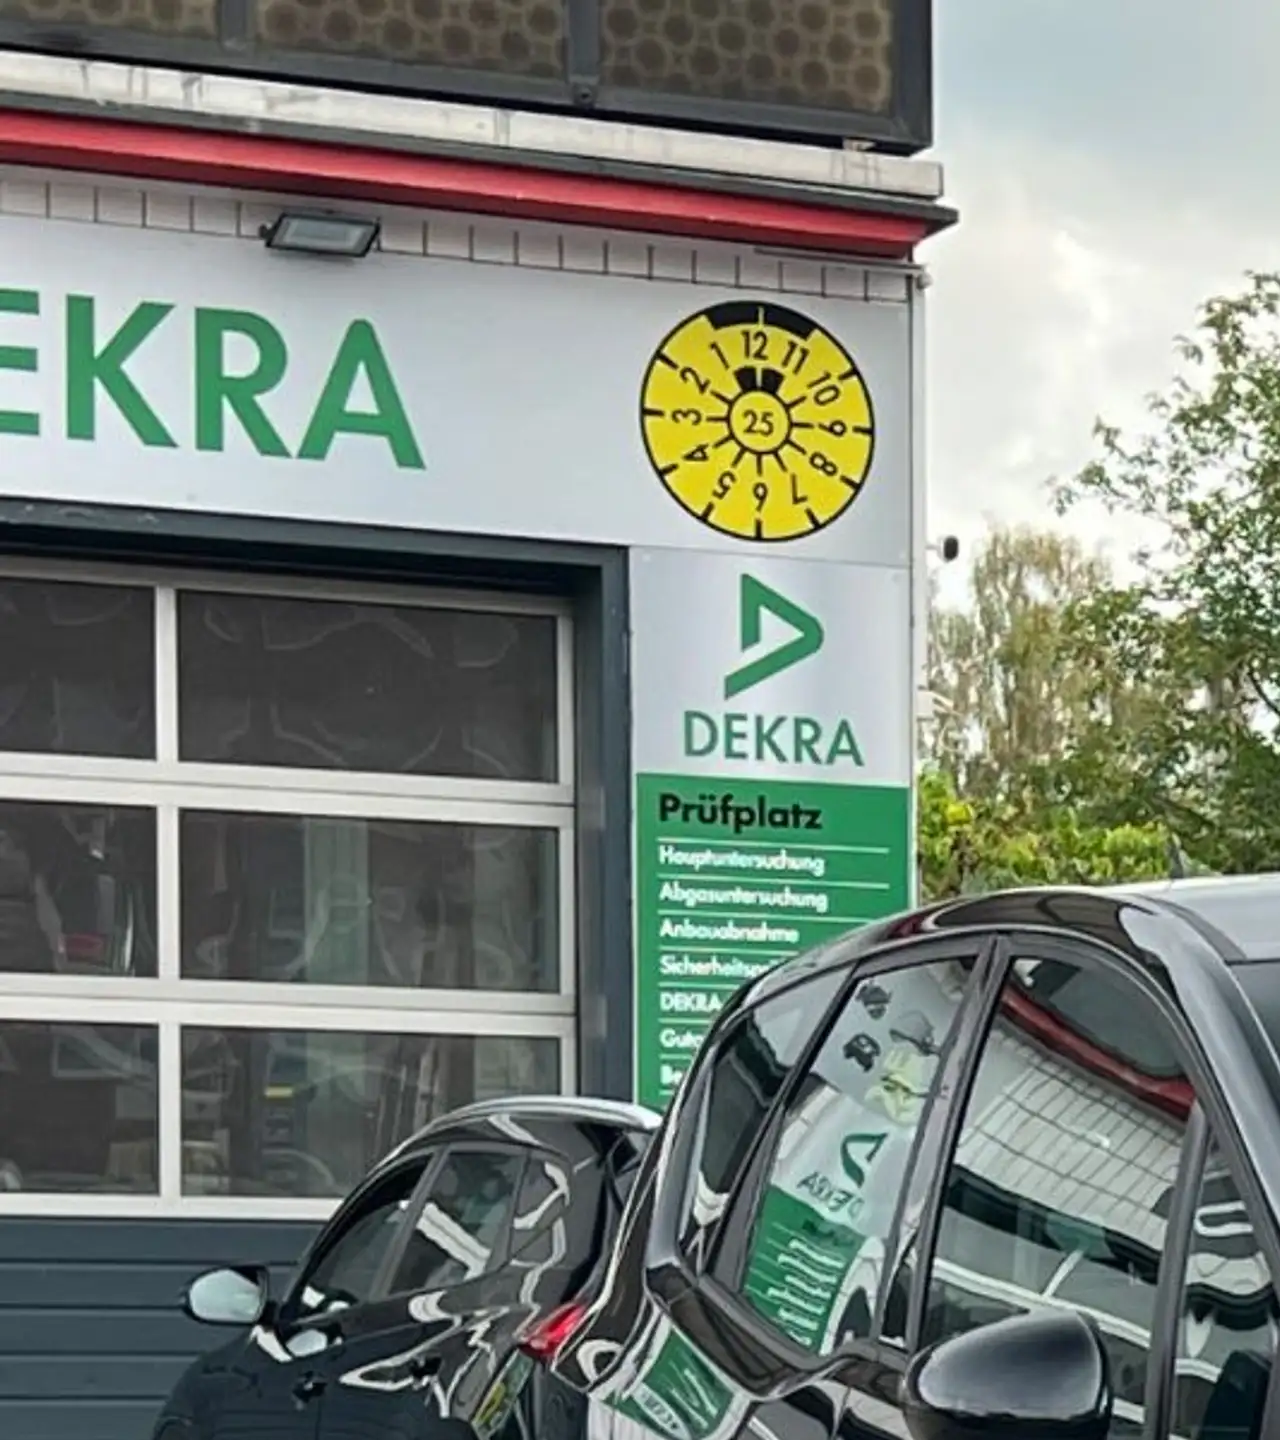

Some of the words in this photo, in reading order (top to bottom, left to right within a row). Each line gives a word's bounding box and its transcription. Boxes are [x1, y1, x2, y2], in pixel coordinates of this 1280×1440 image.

[709, 342, 730, 370] 1
[741, 330, 769, 361] 12
[781, 341, 811, 375] 11
[680, 366, 711, 395] 2
[807, 372, 841, 406] 10
[671, 408, 702, 426] 3
[742, 409, 775, 437] 25
[682, 443, 710, 462] 4
[808, 451, 839, 477] 8
[711, 470, 737, 501] 5
[791, 473, 809, 506] 7
[684, 709, 865, 767] DEKRA
[658, 792, 824, 835] Prüfplatz
[659, 845, 826, 877] Hauptuntersuchung
[659, 882, 828, 913] Abgasuntersuchung
[659, 918, 800, 943] Anbauabnahme
